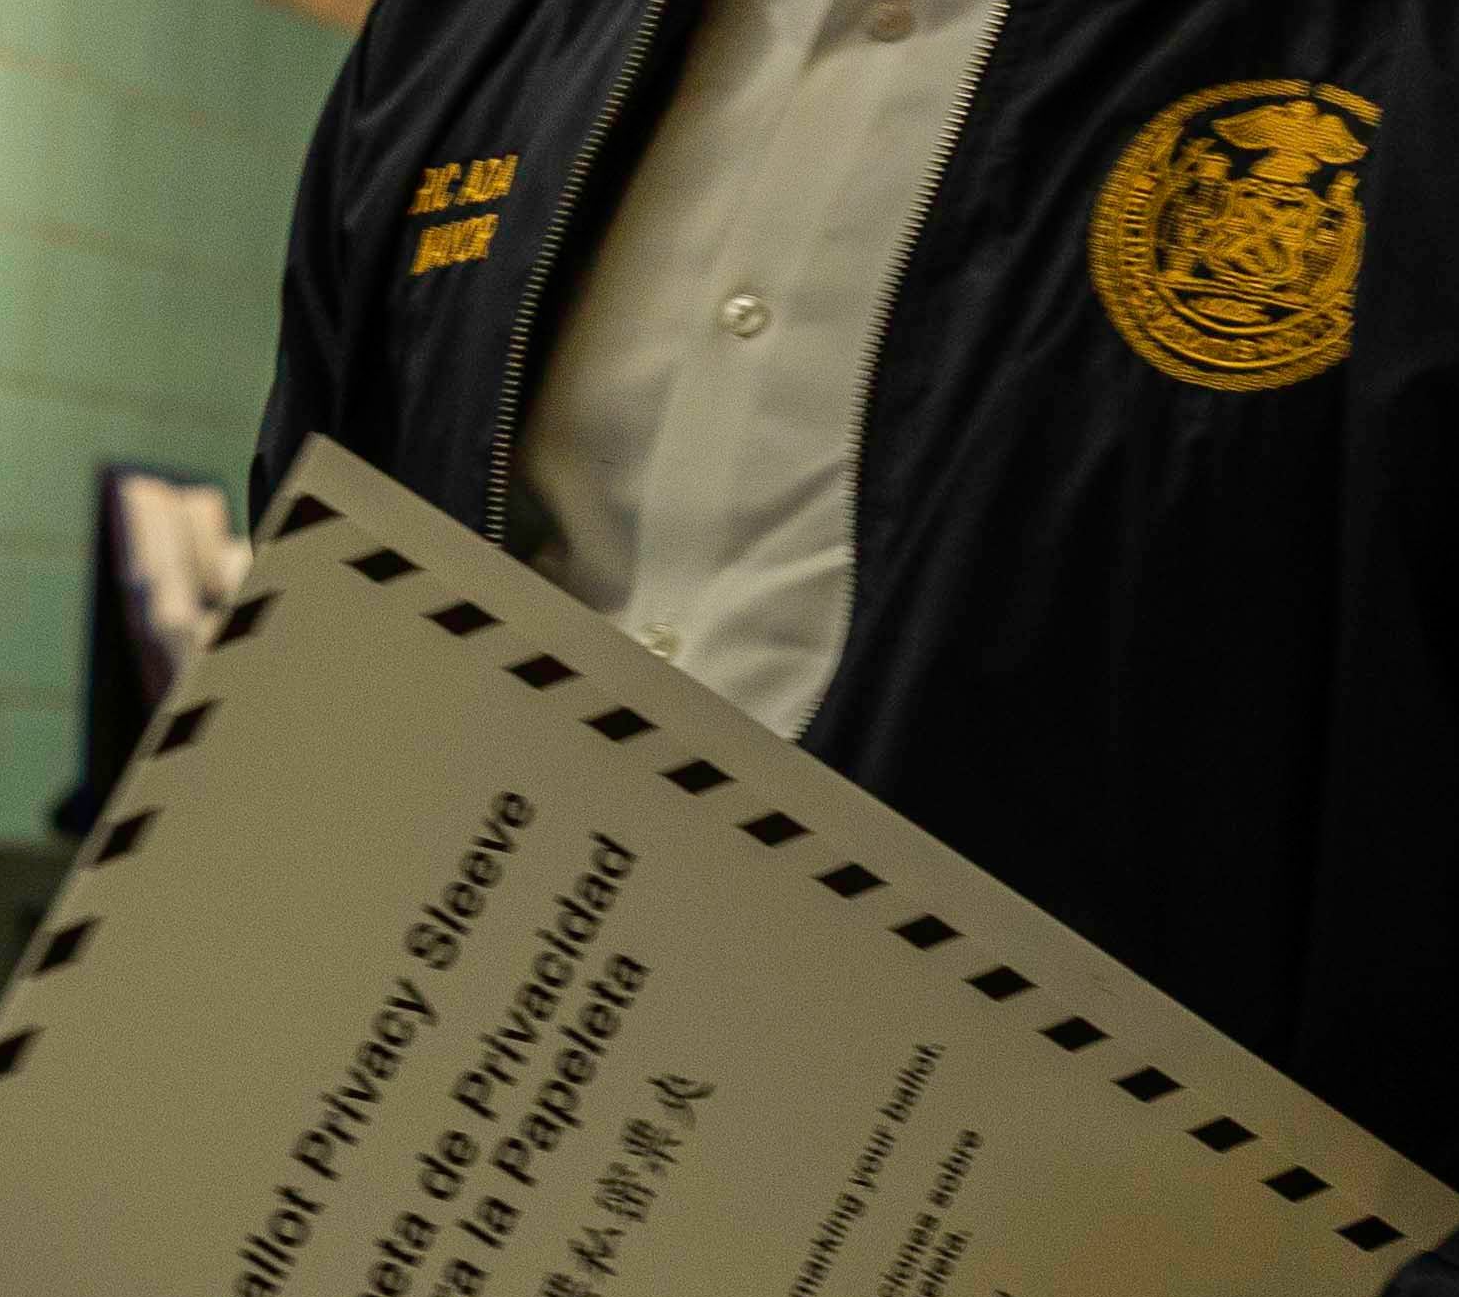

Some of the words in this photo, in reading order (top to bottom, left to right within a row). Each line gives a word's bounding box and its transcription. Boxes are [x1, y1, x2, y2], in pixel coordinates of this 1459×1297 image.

[290, 977, 439, 1182] Privacy
[404, 790, 536, 972] Sleeve
[415, 1129, 480, 1203] de
[449, 830, 639, 1122] Privacidad
[487, 952, 651, 1188] Papeleta
[848, 1126, 897, 1193] your
[878, 1044, 946, 1124] ballot.
[927, 1129, 983, 1209] sobre
[455, 1195, 522, 1251] la
